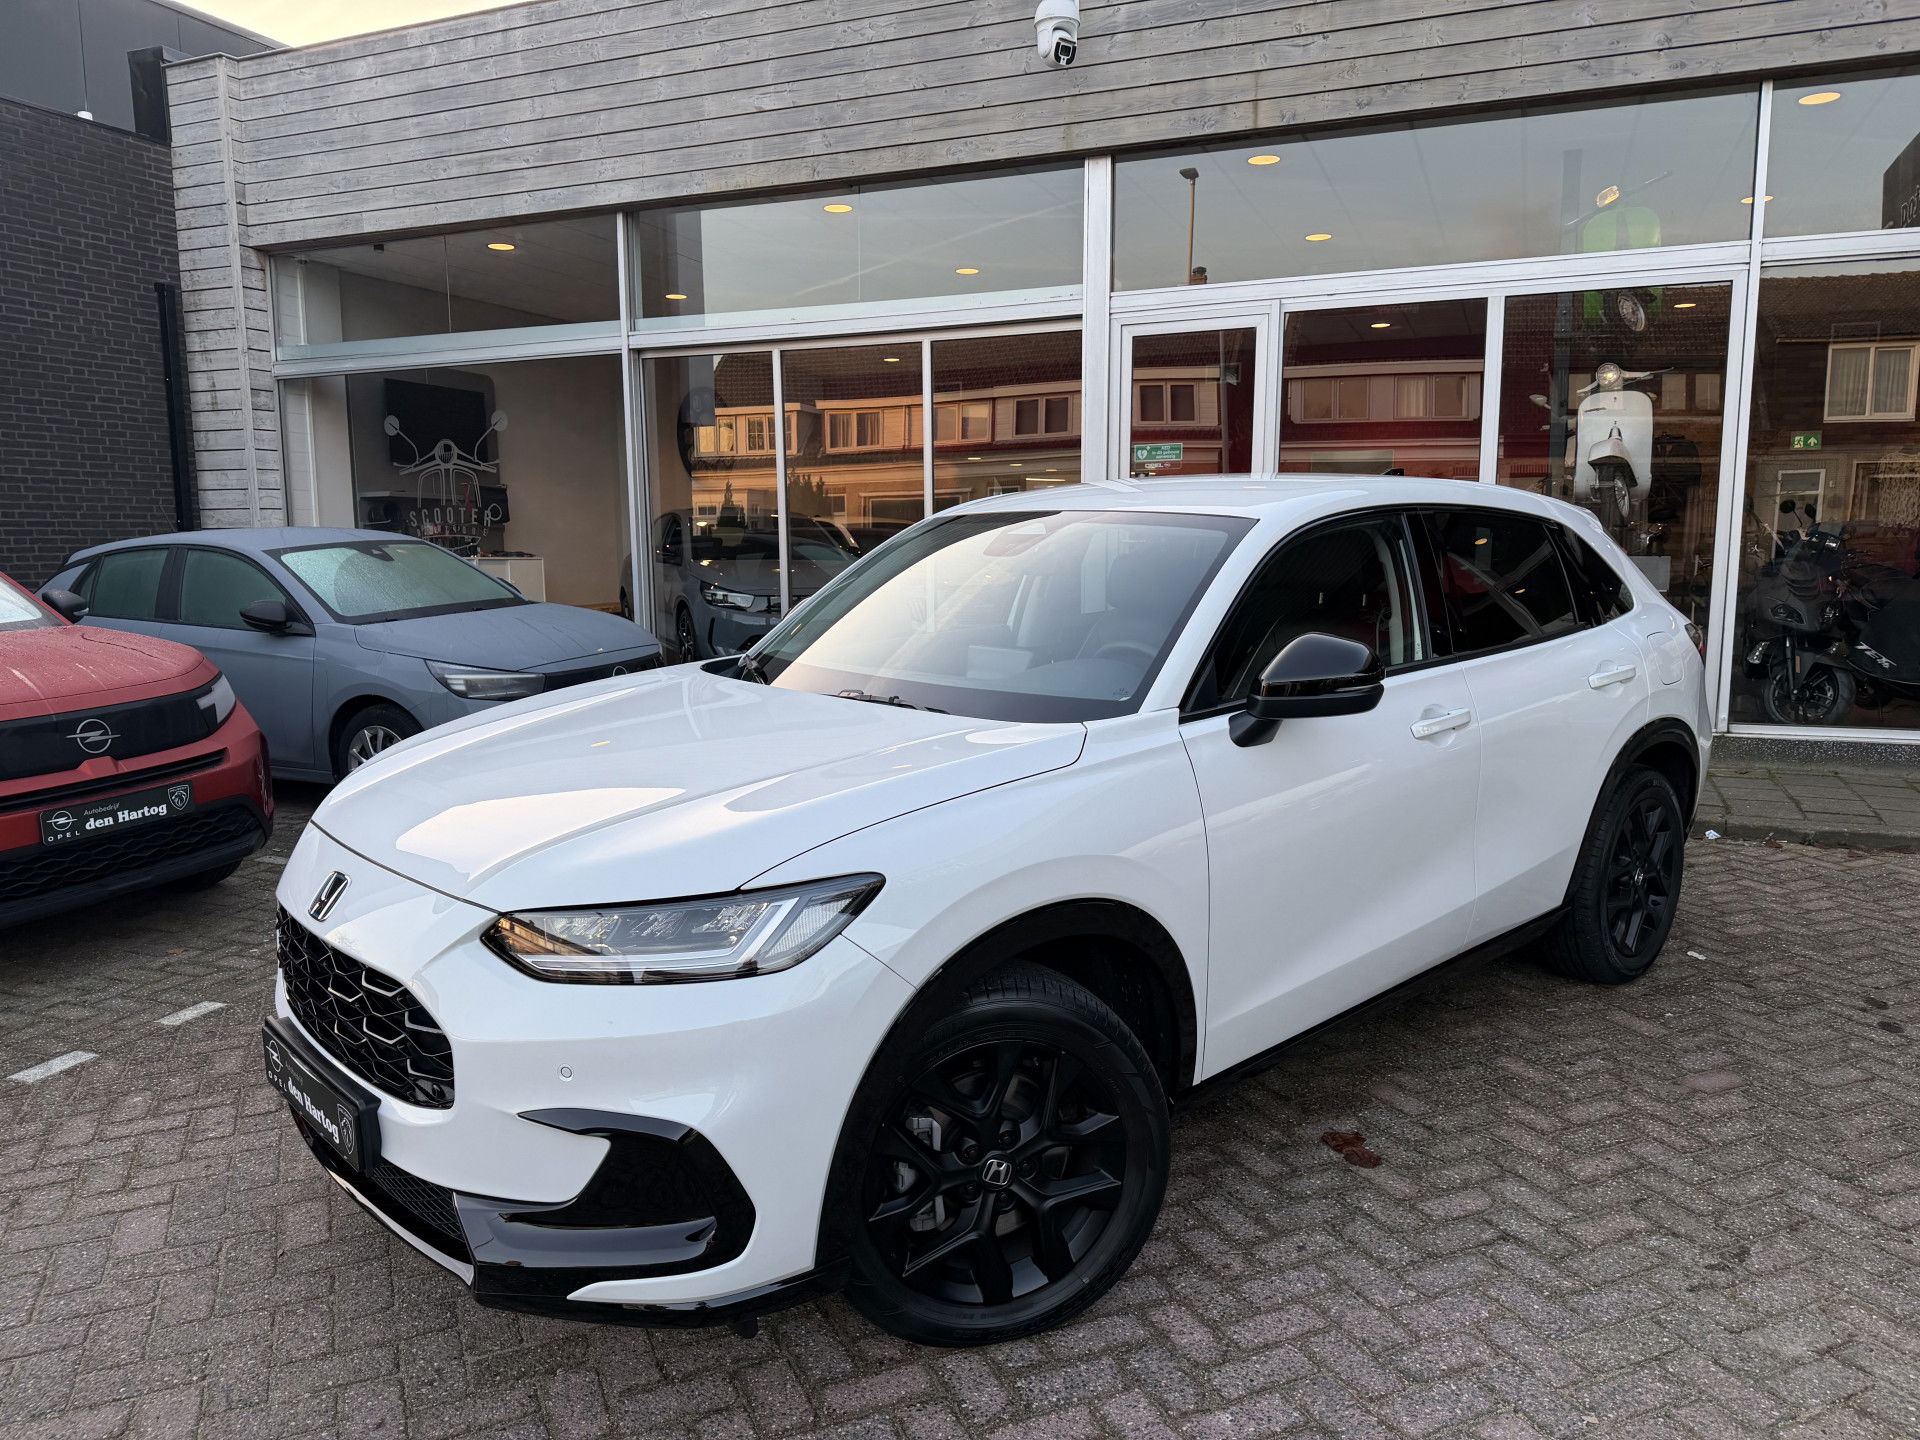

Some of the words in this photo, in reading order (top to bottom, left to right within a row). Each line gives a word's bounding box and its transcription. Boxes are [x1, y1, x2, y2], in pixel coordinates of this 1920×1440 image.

[409, 507, 492, 527] SCOOTER
[83, 801, 121, 816] Autobedrijf
[85, 816, 114, 830] den
[117, 804, 167, 823] Hartog
[47, 830, 81, 842] OPEL
[268, 1070, 288, 1093] OPEL
[287, 1077, 303, 1108] den
[303, 1093, 339, 1144] Hartog
